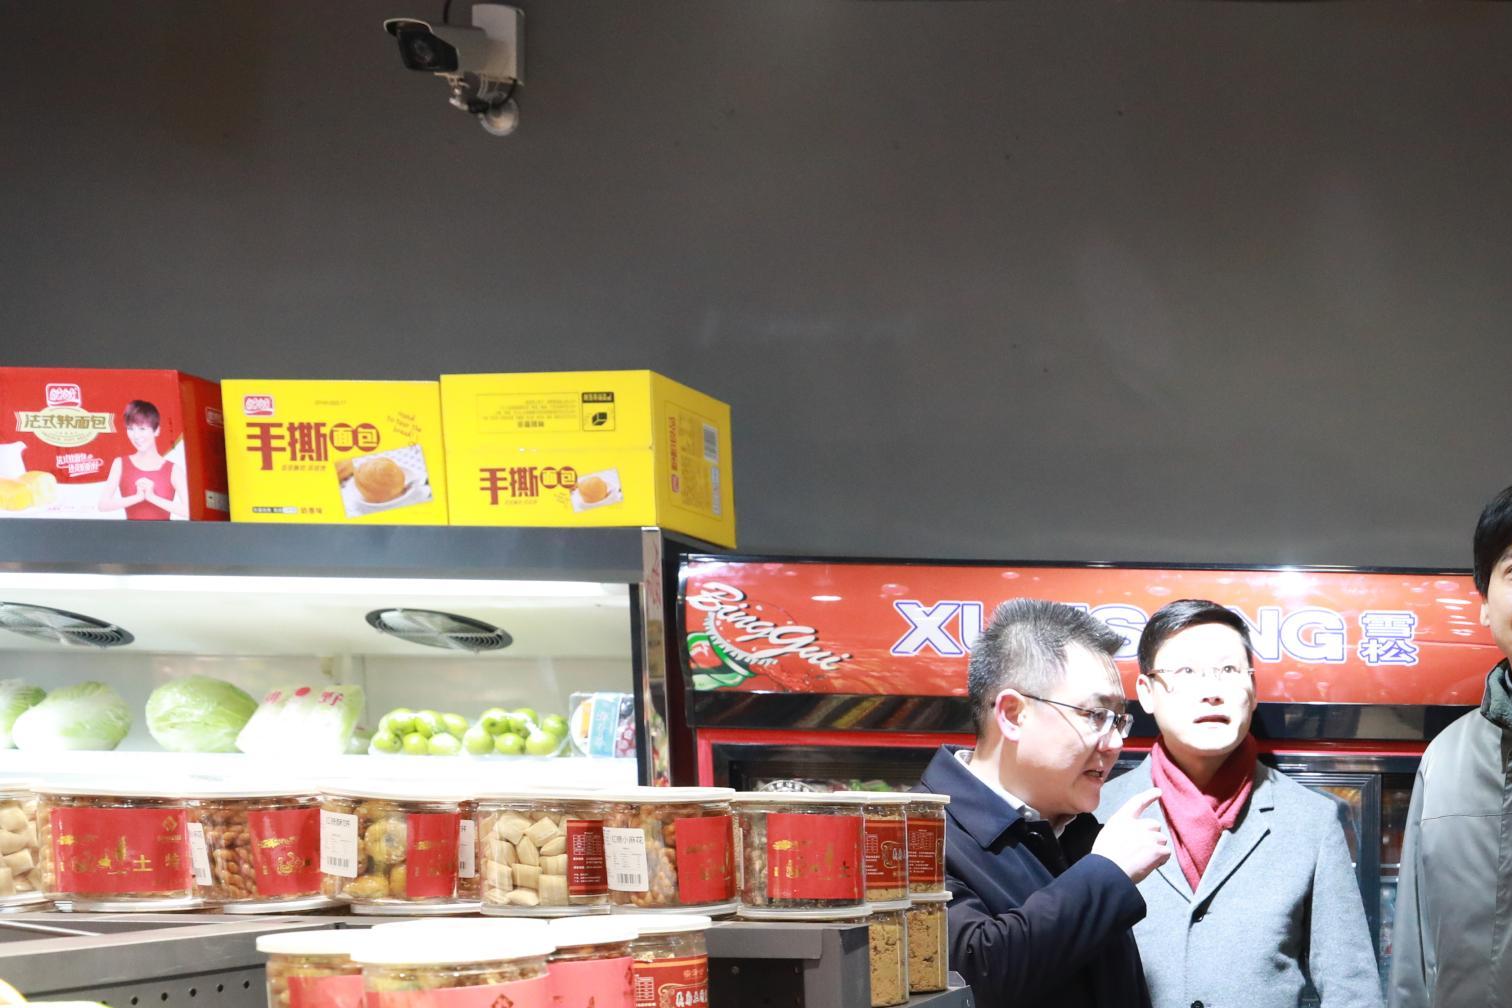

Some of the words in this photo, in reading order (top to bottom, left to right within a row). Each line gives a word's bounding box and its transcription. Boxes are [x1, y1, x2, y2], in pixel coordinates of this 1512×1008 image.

[24, 413, 107, 430] 法式软面包
[245, 421, 382, 472] 手撕面包
[479, 464, 579, 506] 手撕面包
